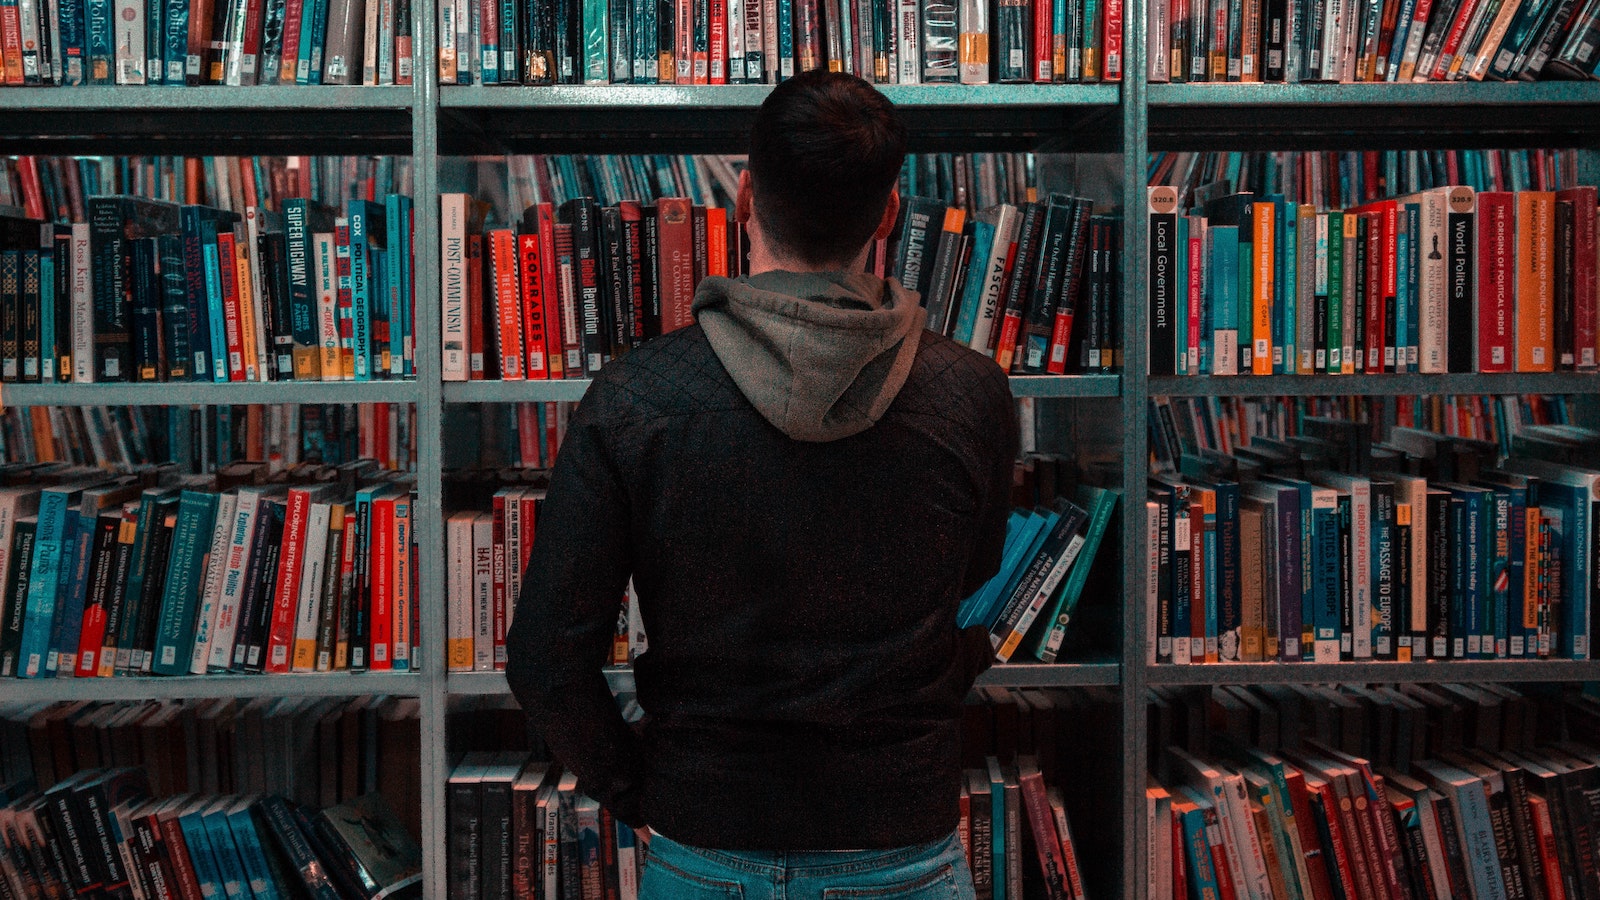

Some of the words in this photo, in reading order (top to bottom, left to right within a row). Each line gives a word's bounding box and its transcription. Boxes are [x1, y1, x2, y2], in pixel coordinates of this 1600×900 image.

[169, 0, 185, 49] Politics
[504, 3, 514, 34] LONE
[1400, 0, 1413, 28] CHISM
[288, 207, 302, 239] SUPER
[353, 215, 361, 236] COX
[580, 208, 588, 231] PONS
[630, 222, 639, 259] UNDER
[943, 233, 954, 266] MODERNISM
[1053, 233, 1062, 246] The
[1157, 221, 1167, 252] Local
[1455, 221, 1465, 254] World
[77, 239, 87, 264] Ross
[290, 242, 306, 286] HIGHWAY
[580, 247, 590, 258] The
[672, 250, 681, 263] OF
[682, 253, 690, 271] THE
[903, 228, 925, 290] BLACKSHIR
[1049, 247, 1059, 271] Oxford
[1497, 257, 1504, 267] OF
[74, 268, 88, 293] King
[113, 254, 122, 279] Oxford
[355, 243, 364, 293] POLITICAL
[501, 273, 511, 286] THE
[581, 259, 596, 287] Global
[612, 272, 620, 281] of
[632, 263, 640, 284] THE
[939, 267, 947, 279] AND
[1455, 258, 1465, 298] Politics
[446, 237, 461, 333] POST-COMMUNISM
[528, 252, 543, 341] COMRADES
[633, 286, 641, 307] RED
[673, 265, 682, 326] COMMUNISM
[683, 273, 691, 292] RISE
[935, 280, 945, 302] FASCISM
[985, 257, 1005, 319] FASCISM
[1043, 272, 1055, 307] Handbook
[1156, 255, 1168, 327] Government
[114, 281, 122, 316] Handbook
[225, 301, 237, 318] STATE
[503, 290, 512, 304] RED
[583, 288, 599, 334] Revolution
[613, 282, 624, 322] Communist
[77, 302, 87, 350] Machiavelli
[114, 319, 123, 328] of
[294, 303, 302, 332] PARRY
[504, 307, 513, 324] FLAG
[635, 309, 643, 337] FLAG
[684, 304, 692, 323] FALL
[1042, 307, 1049, 318] of
[227, 319, 238, 346] BUILDING
[356, 297, 366, 357] GEOGRAPHY
[616, 323, 625, 344] Power
[41, 495, 62, 541] COMPARATIVE
[190, 513, 199, 531] THE
[233, 512, 249, 544] Exploring
[290, 495, 301, 540] EXPLORING
[1160, 503, 1168, 528] AFTER
[1469, 511, 1477, 543] European
[1497, 500, 1507, 529] SUPER
[1160, 530, 1168, 545] THE
[1223, 521, 1233, 567] Political
[1325, 513, 1335, 559] POLITICS
[1381, 527, 1389, 539] THE
[1497, 530, 1507, 557] STATE
[19, 533, 32, 570] Patterns
[38, 544, 57, 574] POLITICS
[115, 545, 128, 582] COMPARING
[184, 533, 195, 568] BRITISH
[204, 525, 223, 599] CONSERVATISM
[231, 546, 243, 569] British
[286, 541, 296, 571] BRITISH
[477, 547, 490, 574] HATE
[494, 543, 503, 583] FASCISM
[1160, 548, 1168, 565] FALL
[1380, 541, 1390, 581] PASSAGE
[1469, 544, 1477, 569] politics
[17, 571, 29, 581] of
[1038, 556, 1054, 577] ARAB
[1326, 562, 1336, 573] IN
[112, 585, 121, 604] ASIAN
[226, 570, 240, 597] Politics
[281, 573, 292, 608] POLITICS
[1380, 583, 1390, 594] TO
[1468, 571, 1477, 591] today
[10, 583, 26, 631] Democracy
[172, 570, 190, 639] CONSTITUTION
[1007, 577, 1042, 625] NATIONALISM
[1222, 570, 1234, 627] Biography
[1326, 577, 1336, 617] EUROPE
[108, 605, 119, 633] POLITICS
[1380, 596, 1391, 632] EUROPE
[58, 799, 68, 811] THE
[88, 797, 97, 808] THE
[62, 811, 76, 839] POPULIST
[92, 809, 105, 837] POPULIST
[271, 803, 289, 830] Political
[288, 831, 307, 860] Thinkers
[546, 812, 556, 841] Orange
[1329, 820, 1338, 837] The
[1384, 809, 1398, 852] ASHDOWN
[1491, 809, 1508, 859] BRITAIN
[1503, 807, 1516, 859] BROWN'S
[1518, 777, 1530, 820] WINSTON
[1527, 823, 1540, 876] CHURCHILL
[70, 839, 83, 864] RADICAL
[100, 837, 113, 863] RADICAL
[137, 826, 150, 854] GARNETT
[144, 830, 153, 848] MARK
[519, 832, 529, 854] The
[1332, 839, 1345, 866] British
[1412, 829, 1424, 861] BRITAIN
[79, 865, 90, 883] RIGHT
[109, 863, 119, 881] RIGHT
[518, 856, 530, 884] Clash
[547, 844, 557, 876] Parades
[1503, 866, 1515, 900] PESTON
[1513, 864, 1524, 898] ROBERT
